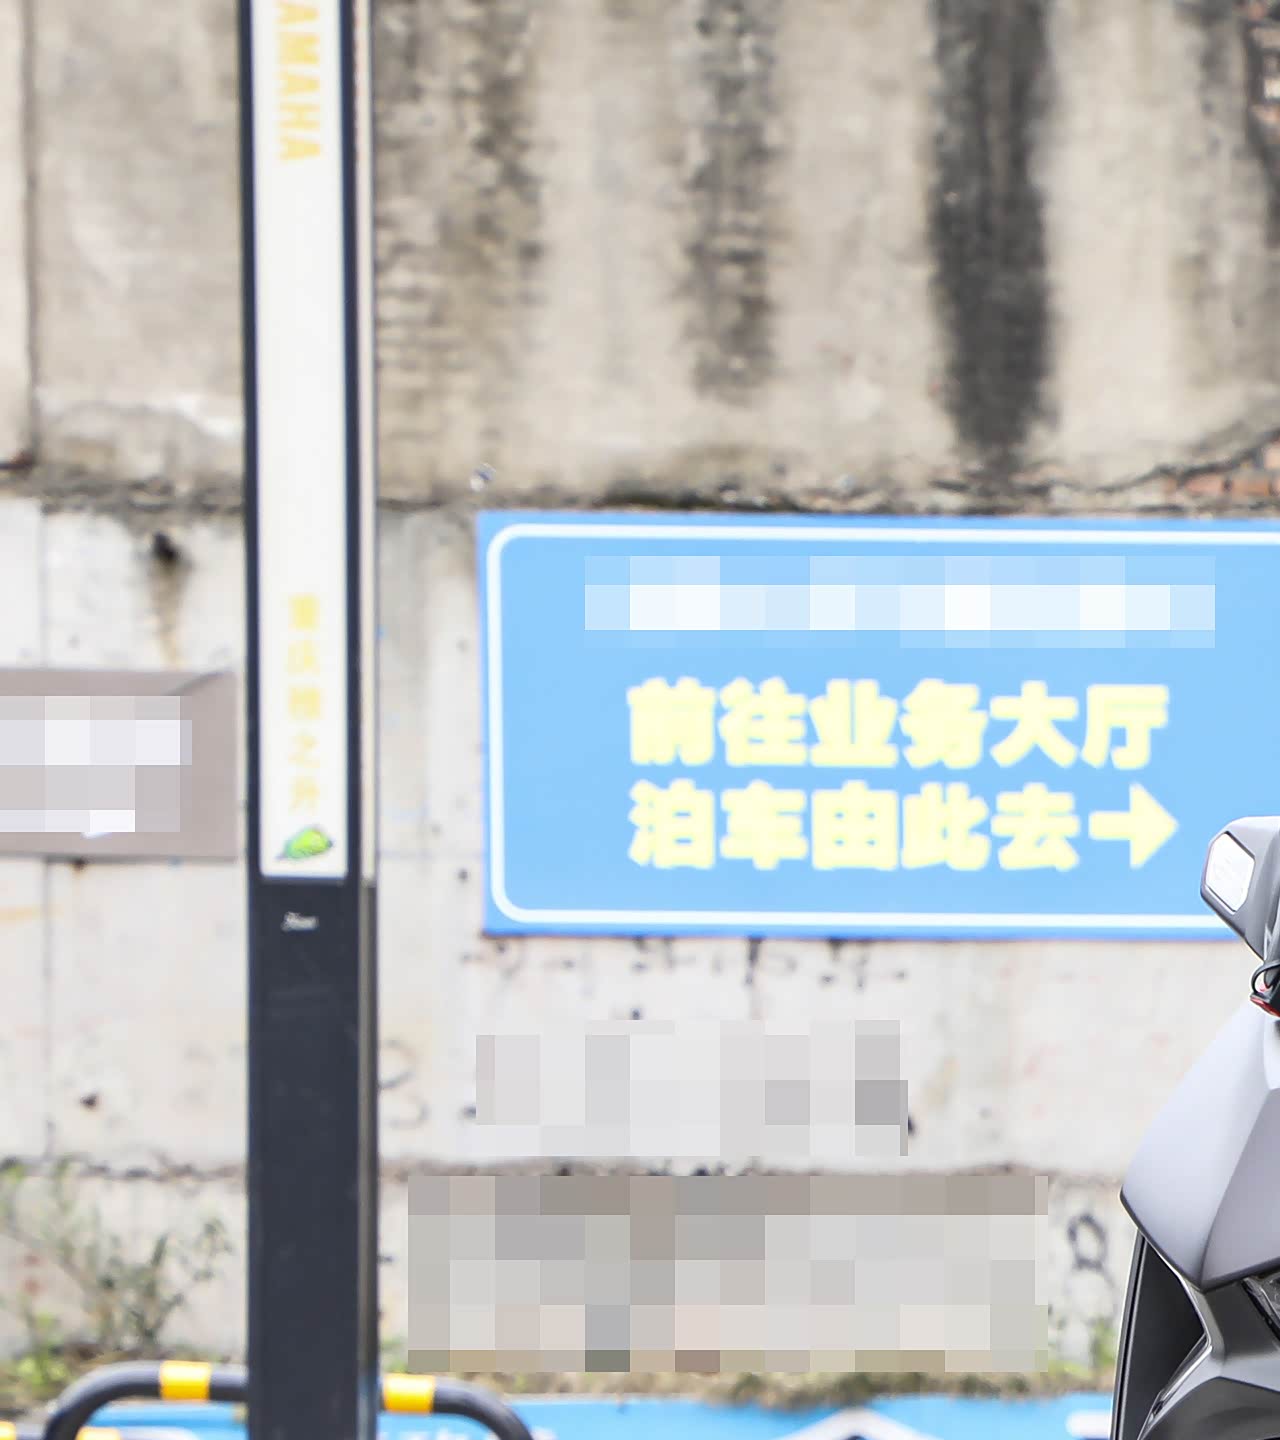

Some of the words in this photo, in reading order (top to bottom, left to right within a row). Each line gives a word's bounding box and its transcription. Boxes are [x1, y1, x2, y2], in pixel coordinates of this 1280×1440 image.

[626, 676, 1171, 770] 前往业务大厅
[628, 778, 1081, 872] 泊车由此去
